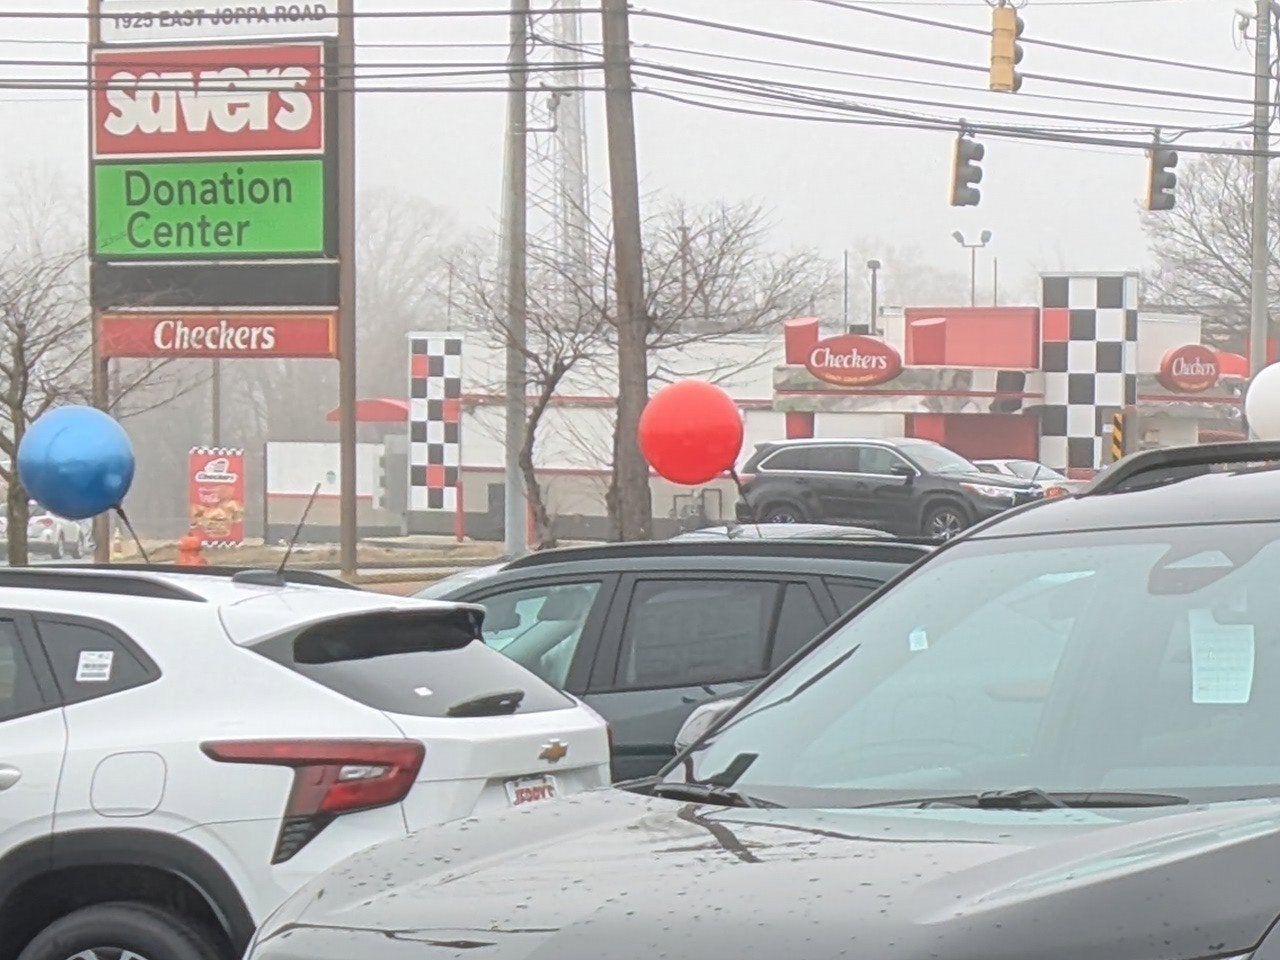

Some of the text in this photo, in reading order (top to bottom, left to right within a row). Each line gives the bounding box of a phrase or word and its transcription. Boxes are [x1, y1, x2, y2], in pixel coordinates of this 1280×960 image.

[113, 4, 327, 29] 1925 EAST JOPPA ROAD
[124, 168, 293, 206] Donation
[126, 211, 250, 249] Center
[153, 320, 276, 350] Checkers
[810, 347, 887, 370] Checkers
